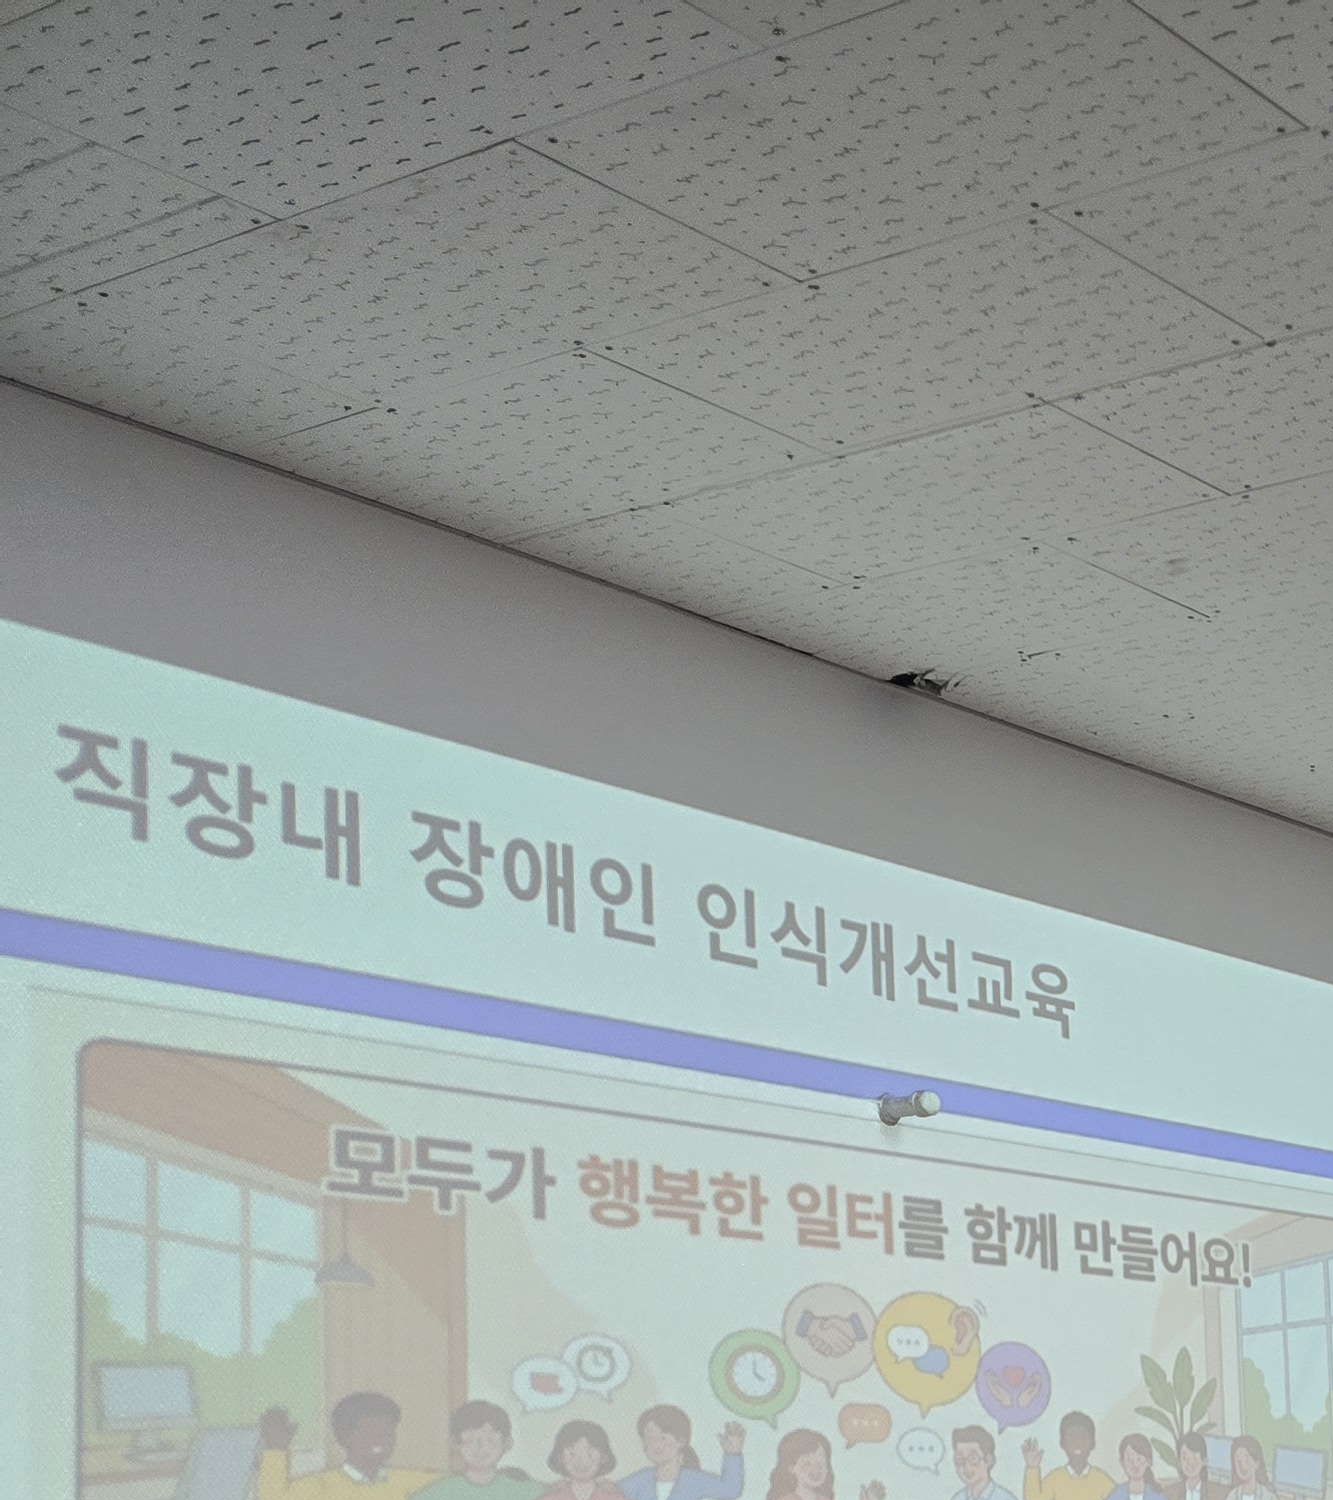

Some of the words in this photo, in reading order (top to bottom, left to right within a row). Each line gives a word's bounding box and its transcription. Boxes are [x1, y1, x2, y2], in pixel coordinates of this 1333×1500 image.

[54, 723, 360, 887] 직장내
[409, 810, 656, 947] 장애인
[697, 883, 1075, 1040] 인식개선교육
[327, 1129, 556, 1220] 모두가
[577, 1154, 769, 1241] 행복한
[787, 1182, 949, 1260] 일터를
[964, 1203, 1058, 1271] 함께
[1074, 1219, 1252, 1287] 만들어요!
